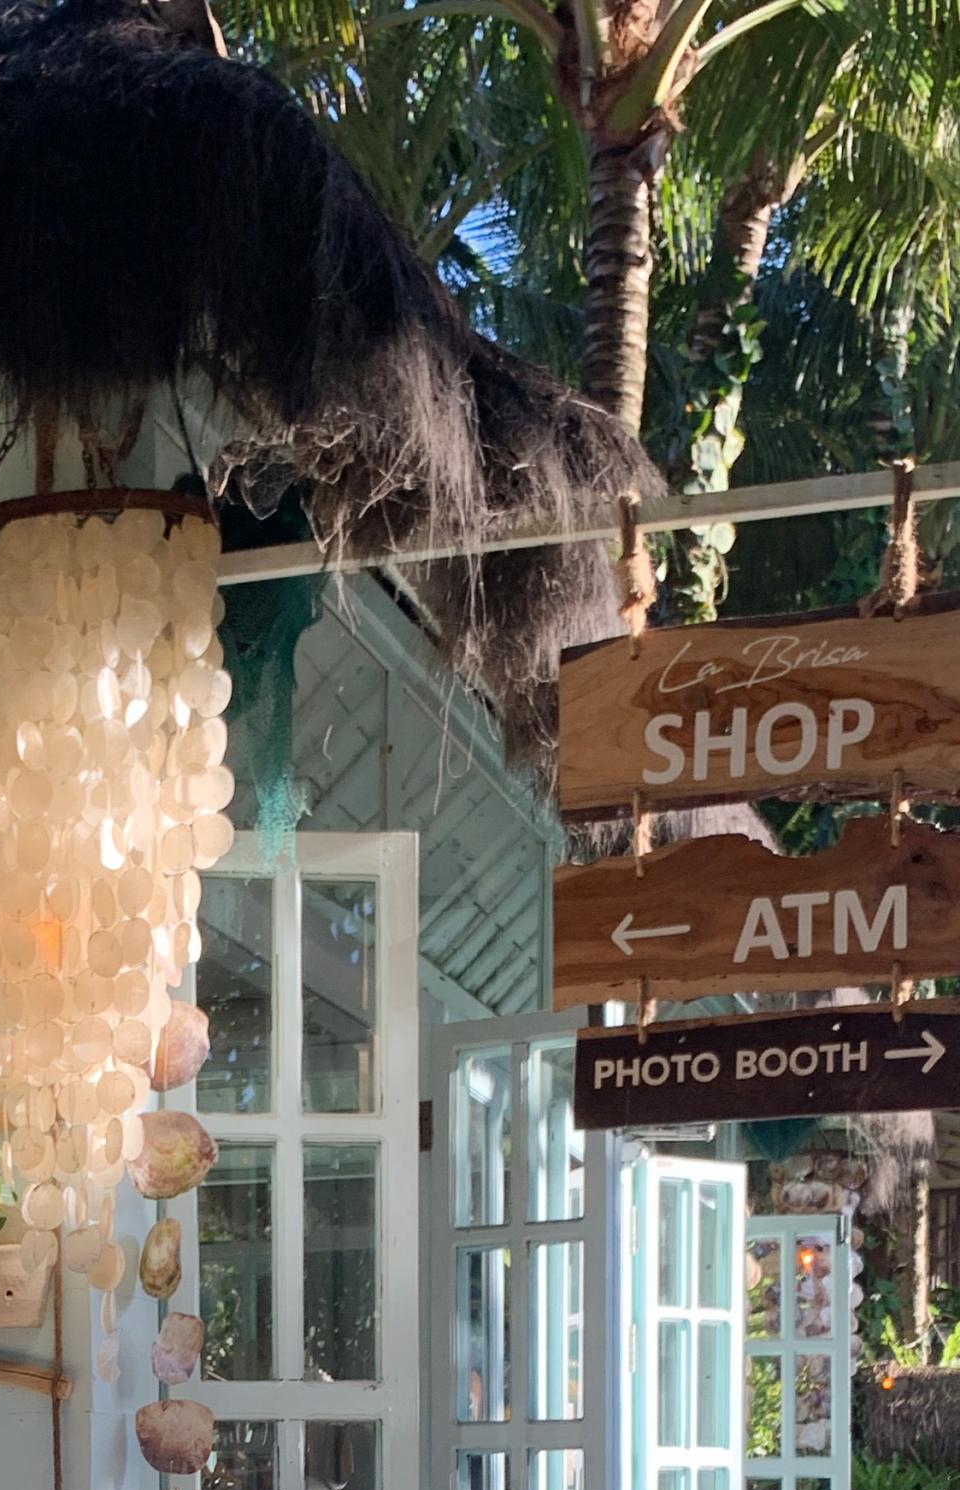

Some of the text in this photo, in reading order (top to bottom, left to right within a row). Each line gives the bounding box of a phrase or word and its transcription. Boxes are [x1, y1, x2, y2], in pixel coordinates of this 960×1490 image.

[658, 634, 869, 696] La Brisa
[641, 698, 876, 786] SHOP
[732, 884, 908, 963] ATM
[592, 1041, 868, 1090] PHOTO BOOTH
